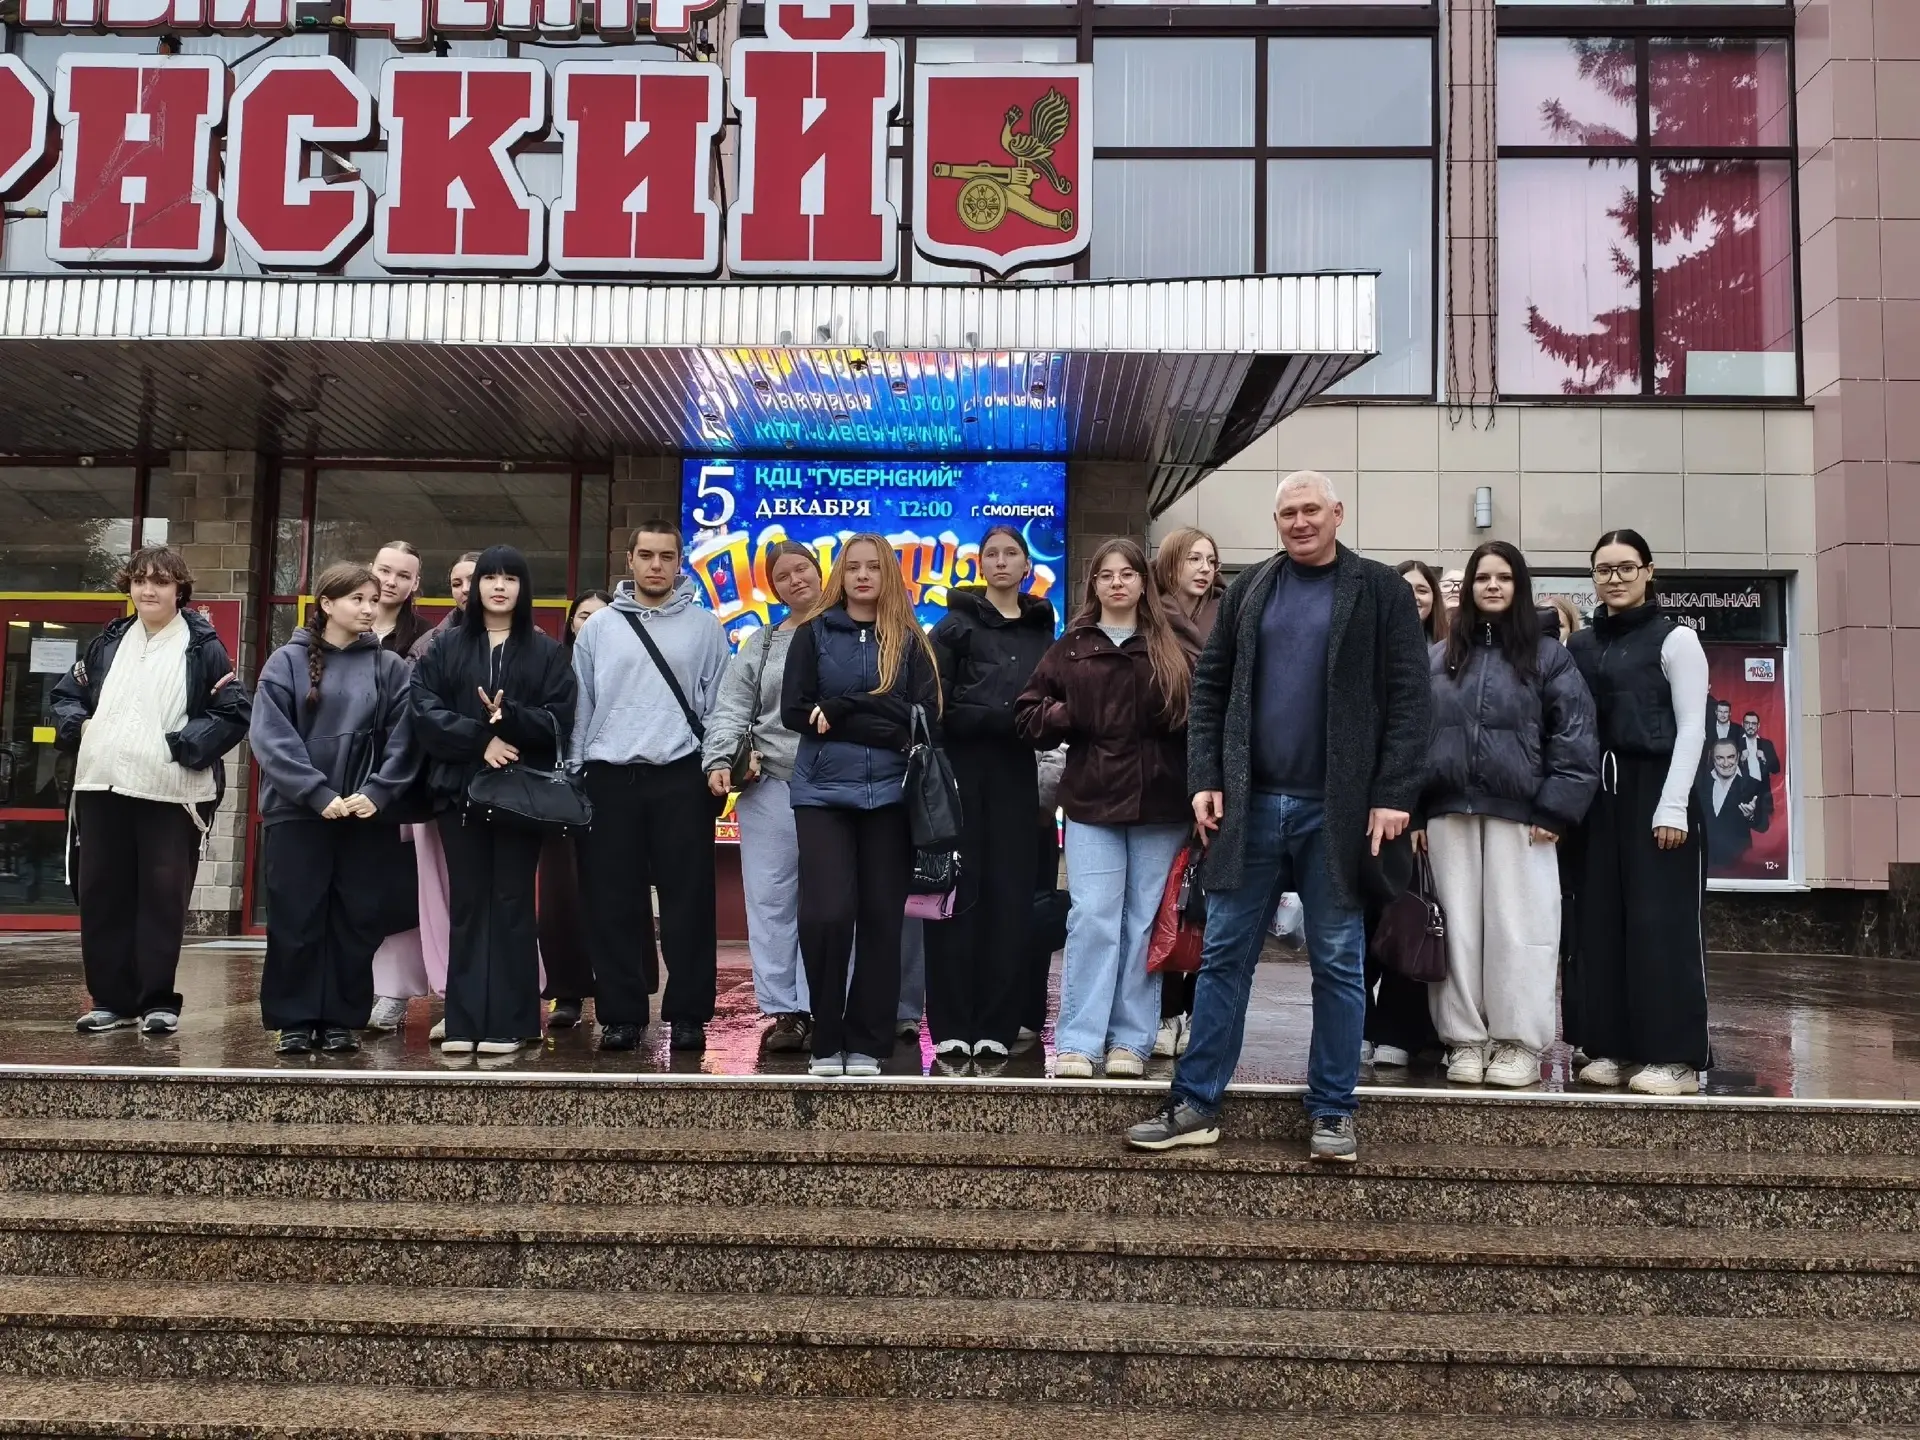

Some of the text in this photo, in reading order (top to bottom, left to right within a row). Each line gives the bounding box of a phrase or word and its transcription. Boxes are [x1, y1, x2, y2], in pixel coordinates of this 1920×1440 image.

[755, 465, 963, 489] КДЦ "ГУБЕРНСКИЙ"
[693, 465, 735, 527] 5
[755, 498, 871, 518] ДЕКАБРЯ
[899, 500, 952, 518] 12:00
[982, 504, 1055, 517] СМОЛЕНСК
[1765, 861, 1780, 870] 12+
